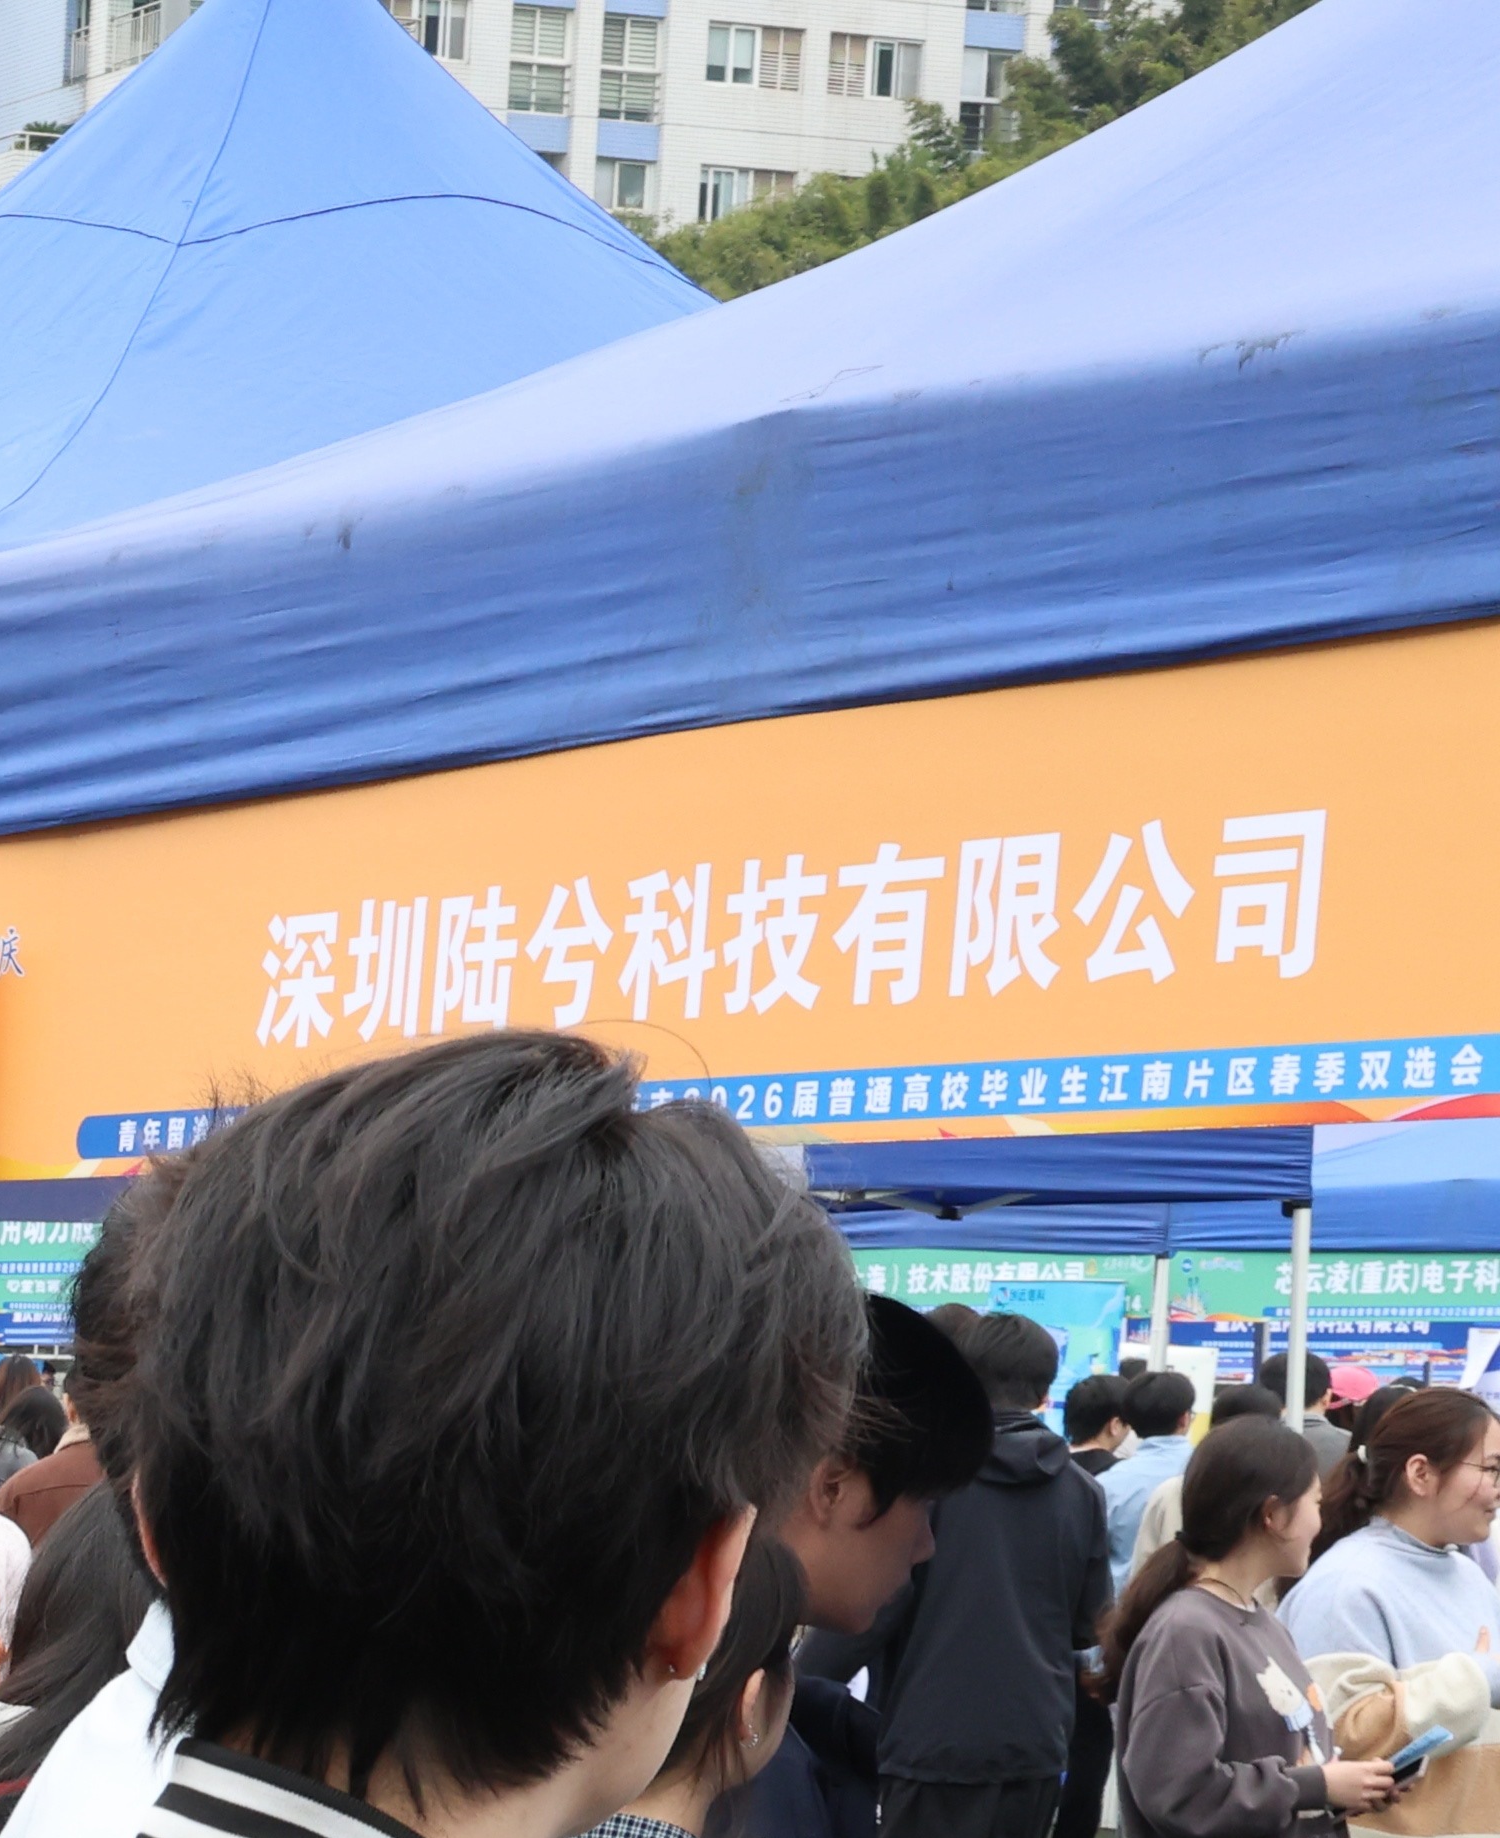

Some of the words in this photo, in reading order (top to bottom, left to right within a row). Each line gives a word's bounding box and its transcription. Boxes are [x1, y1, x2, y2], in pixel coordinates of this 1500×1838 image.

[256, 810, 1327, 1048] 深圳陆兮科技有限公司
